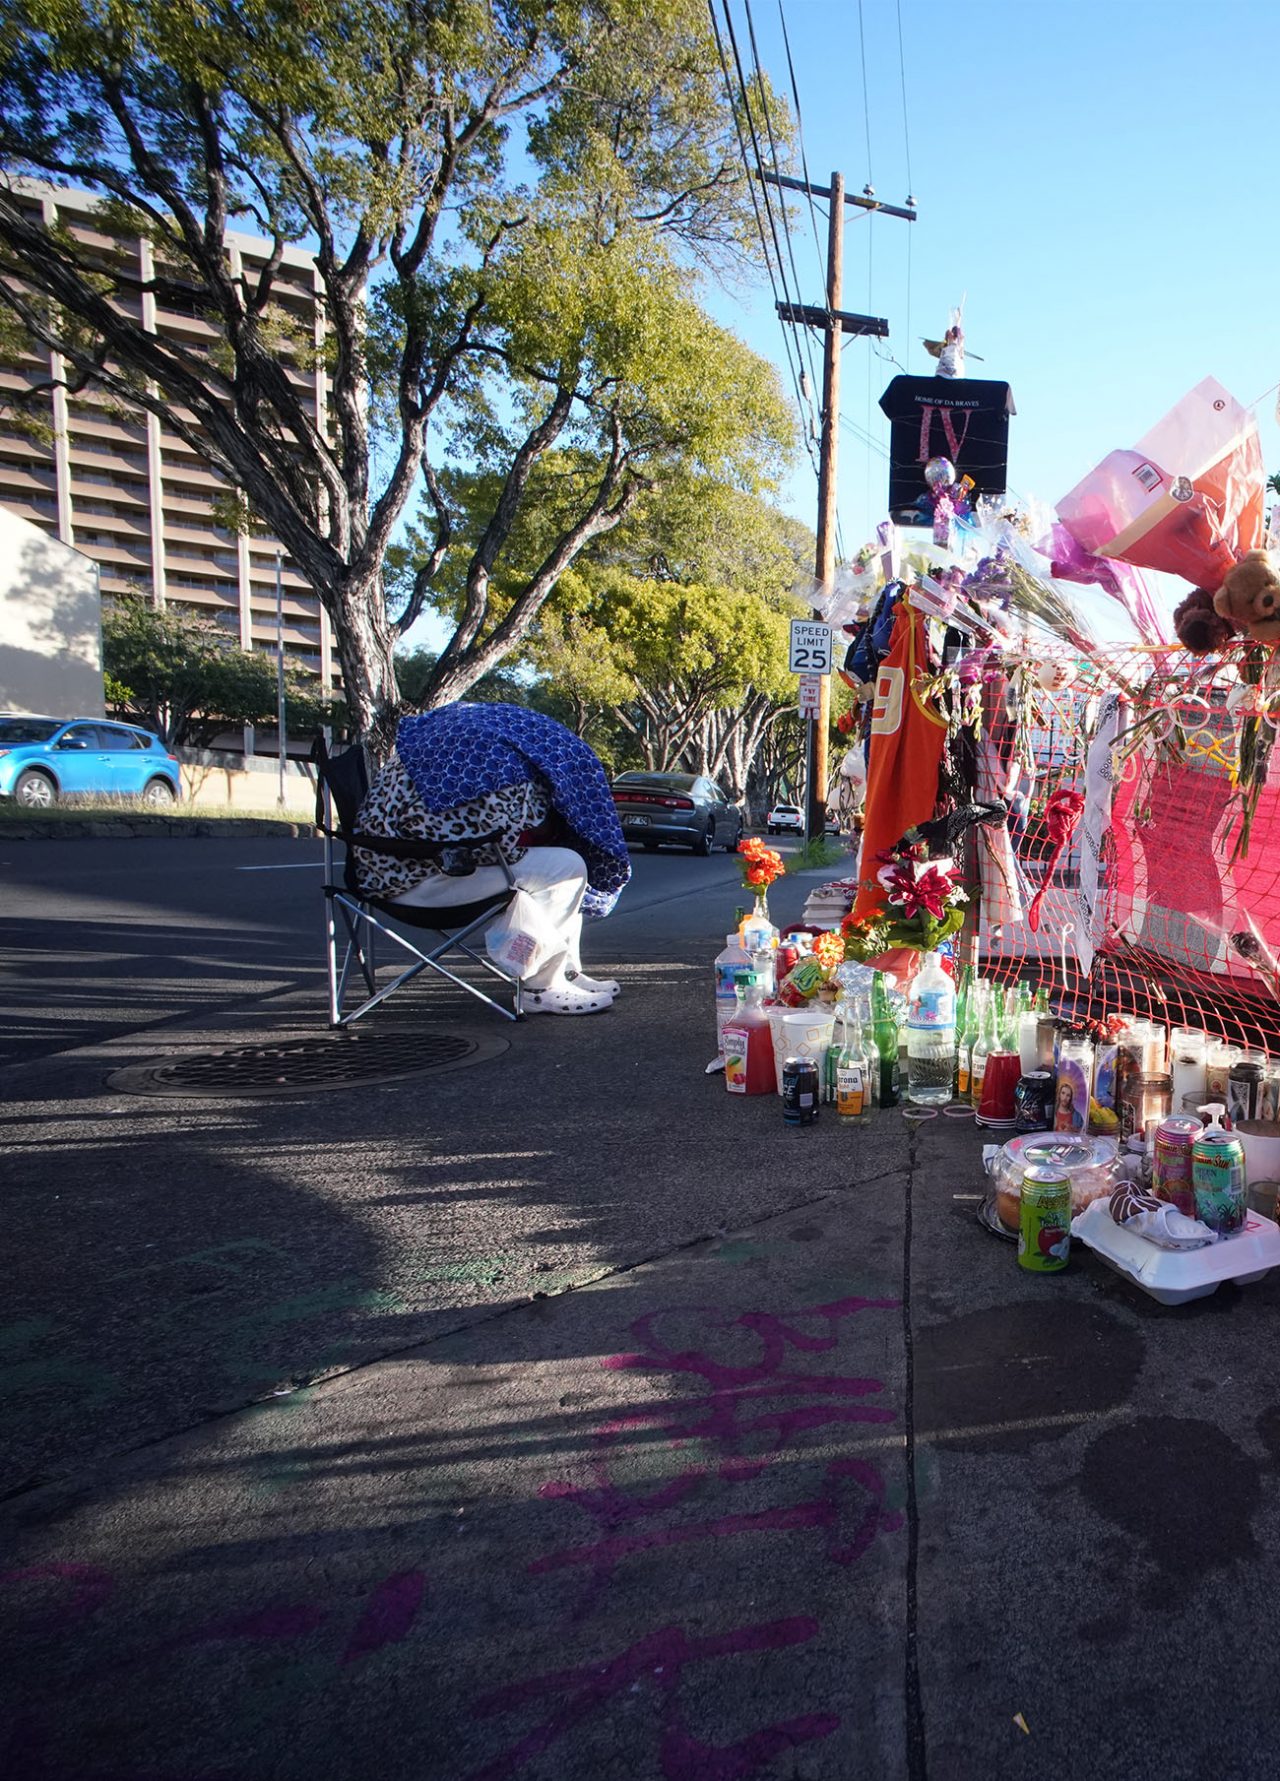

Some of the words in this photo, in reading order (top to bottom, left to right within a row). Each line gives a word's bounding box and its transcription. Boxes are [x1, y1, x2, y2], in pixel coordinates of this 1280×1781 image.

[914, 395, 934, 403] HOME
[794, 626, 829, 637] SPEED
[797, 637, 825, 647] LIMIT
[794, 648, 827, 669] 25
[1213, 1154, 1231, 1169] Sun
